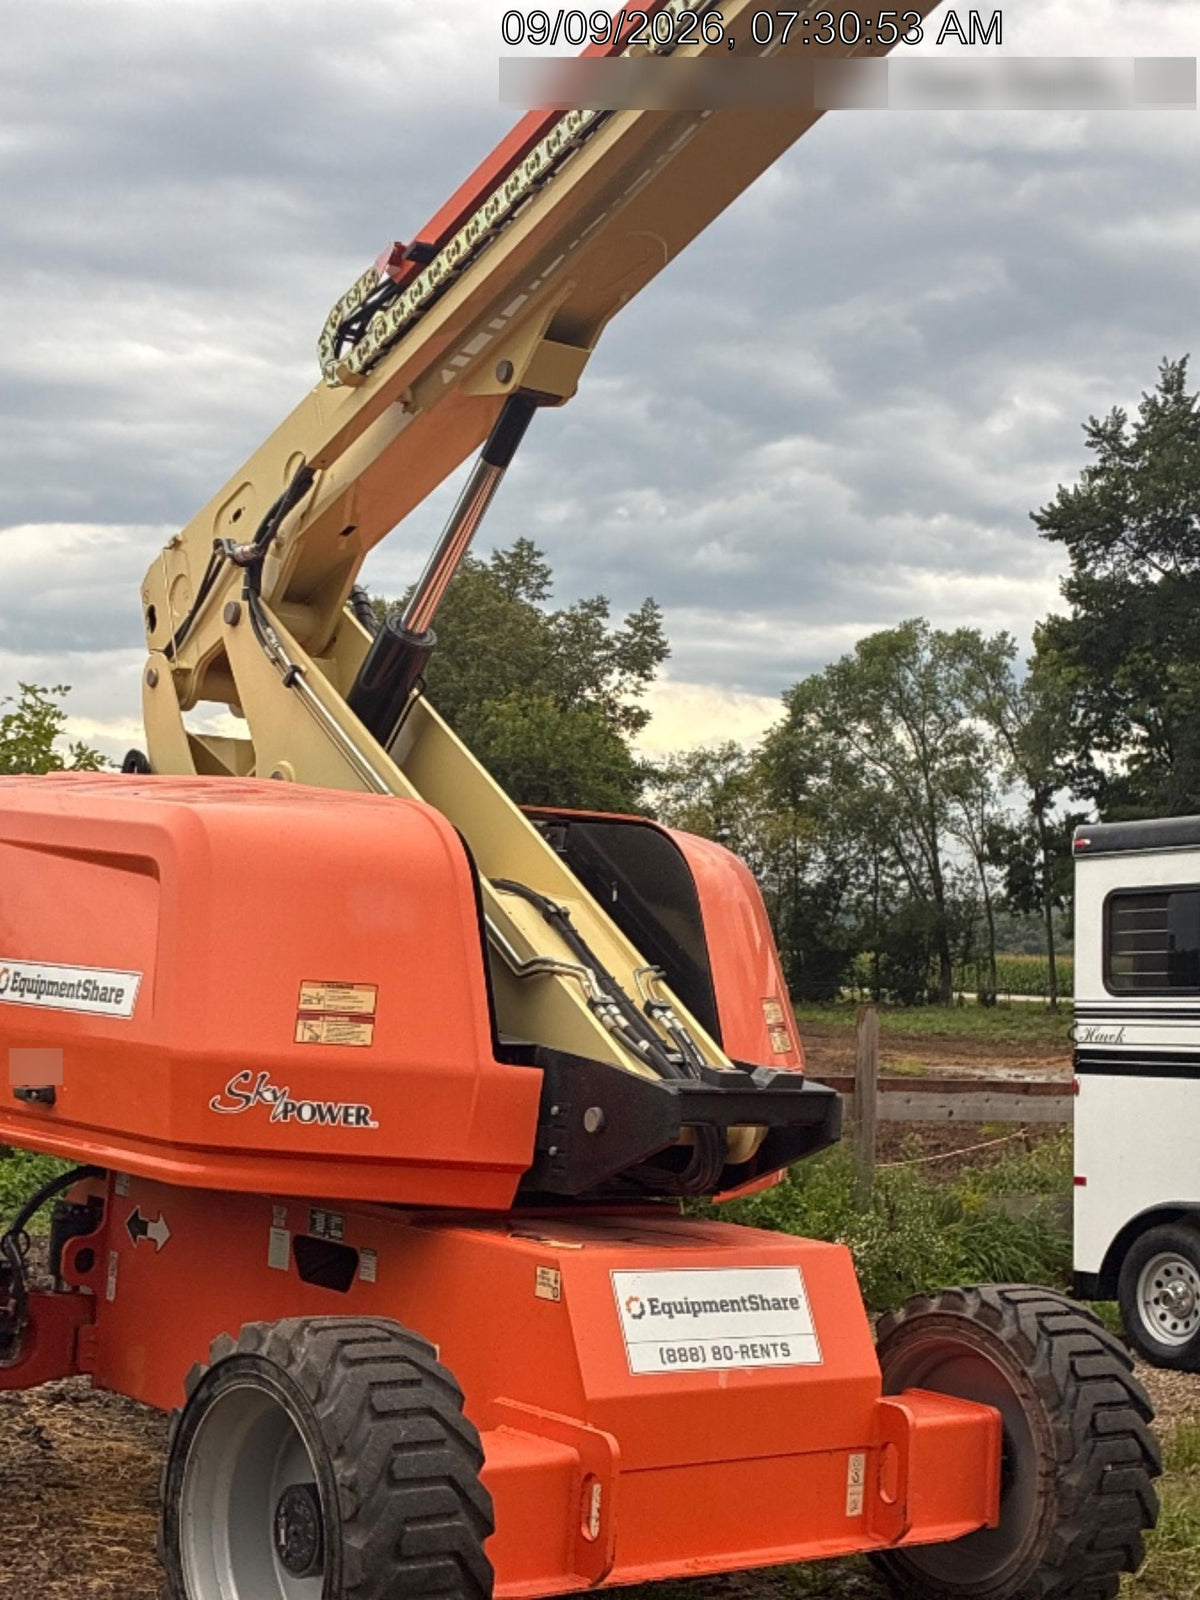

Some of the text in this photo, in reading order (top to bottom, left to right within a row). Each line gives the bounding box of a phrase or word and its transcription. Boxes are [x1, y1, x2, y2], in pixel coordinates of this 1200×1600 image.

[10, 971, 125, 1005] EquipmentShare
[647, 1294, 800, 1319] EquipmentShare
[659, 1342, 791, 1365] (888) 80-RENTS
